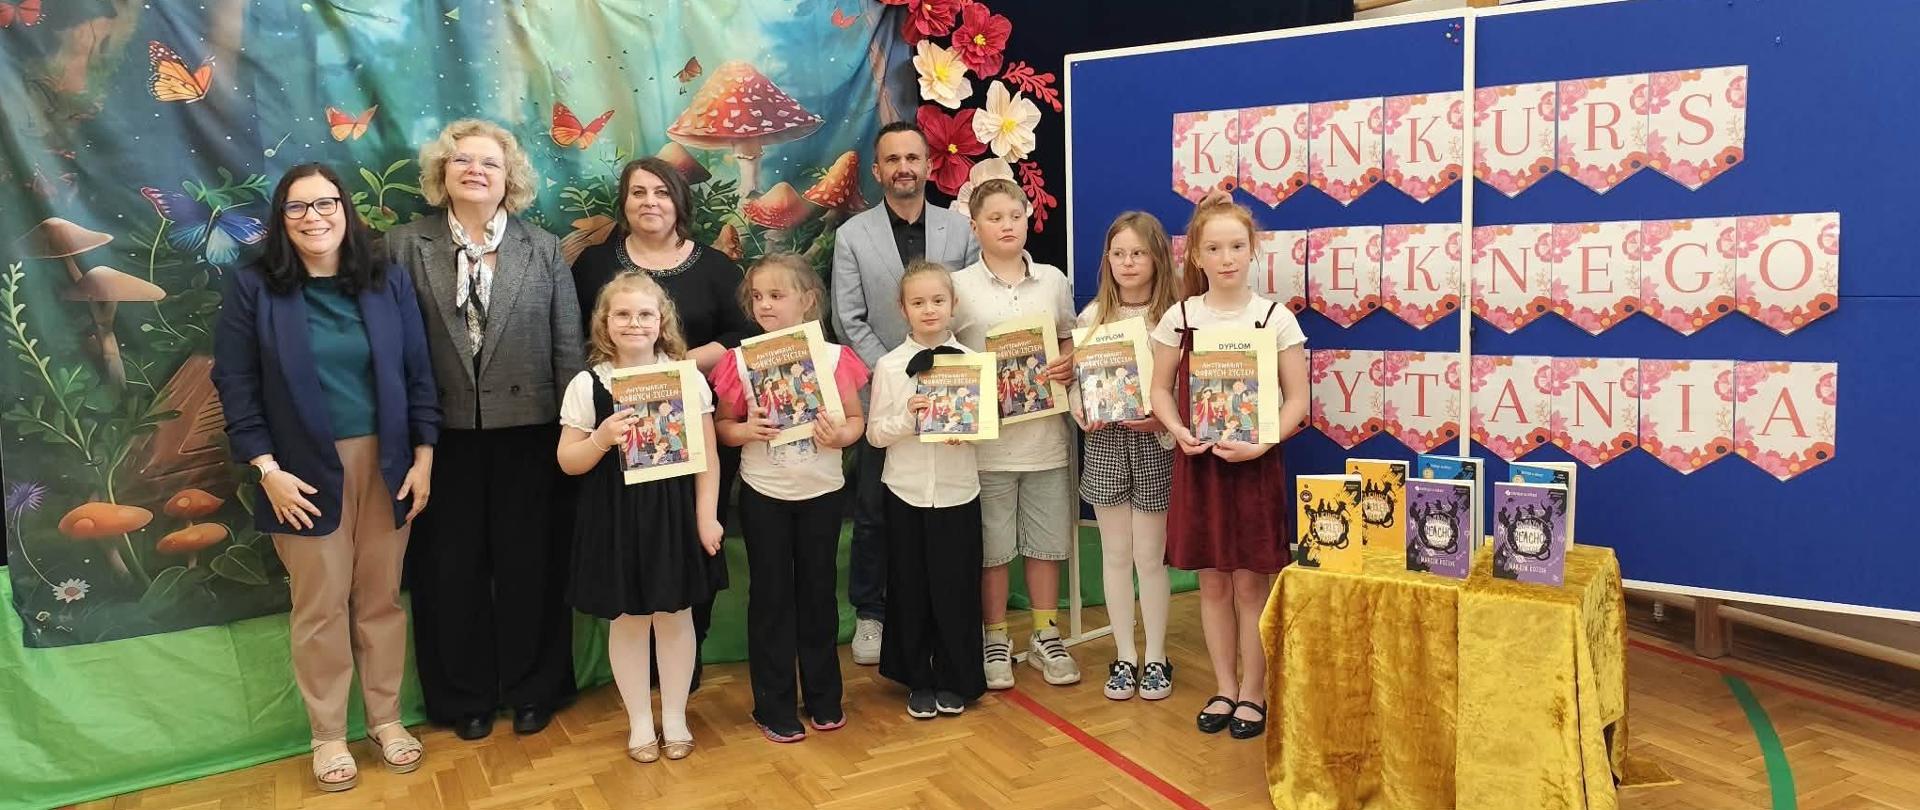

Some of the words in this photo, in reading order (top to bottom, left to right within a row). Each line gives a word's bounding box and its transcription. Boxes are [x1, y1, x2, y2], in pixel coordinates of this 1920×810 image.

[1190, 92, 1715, 175] KONKURS
[1265, 238, 1814, 300] IĘKNEGO
[1095, 332, 1125, 342] DYPLOM
[1329, 370, 1811, 438] YTANIA
